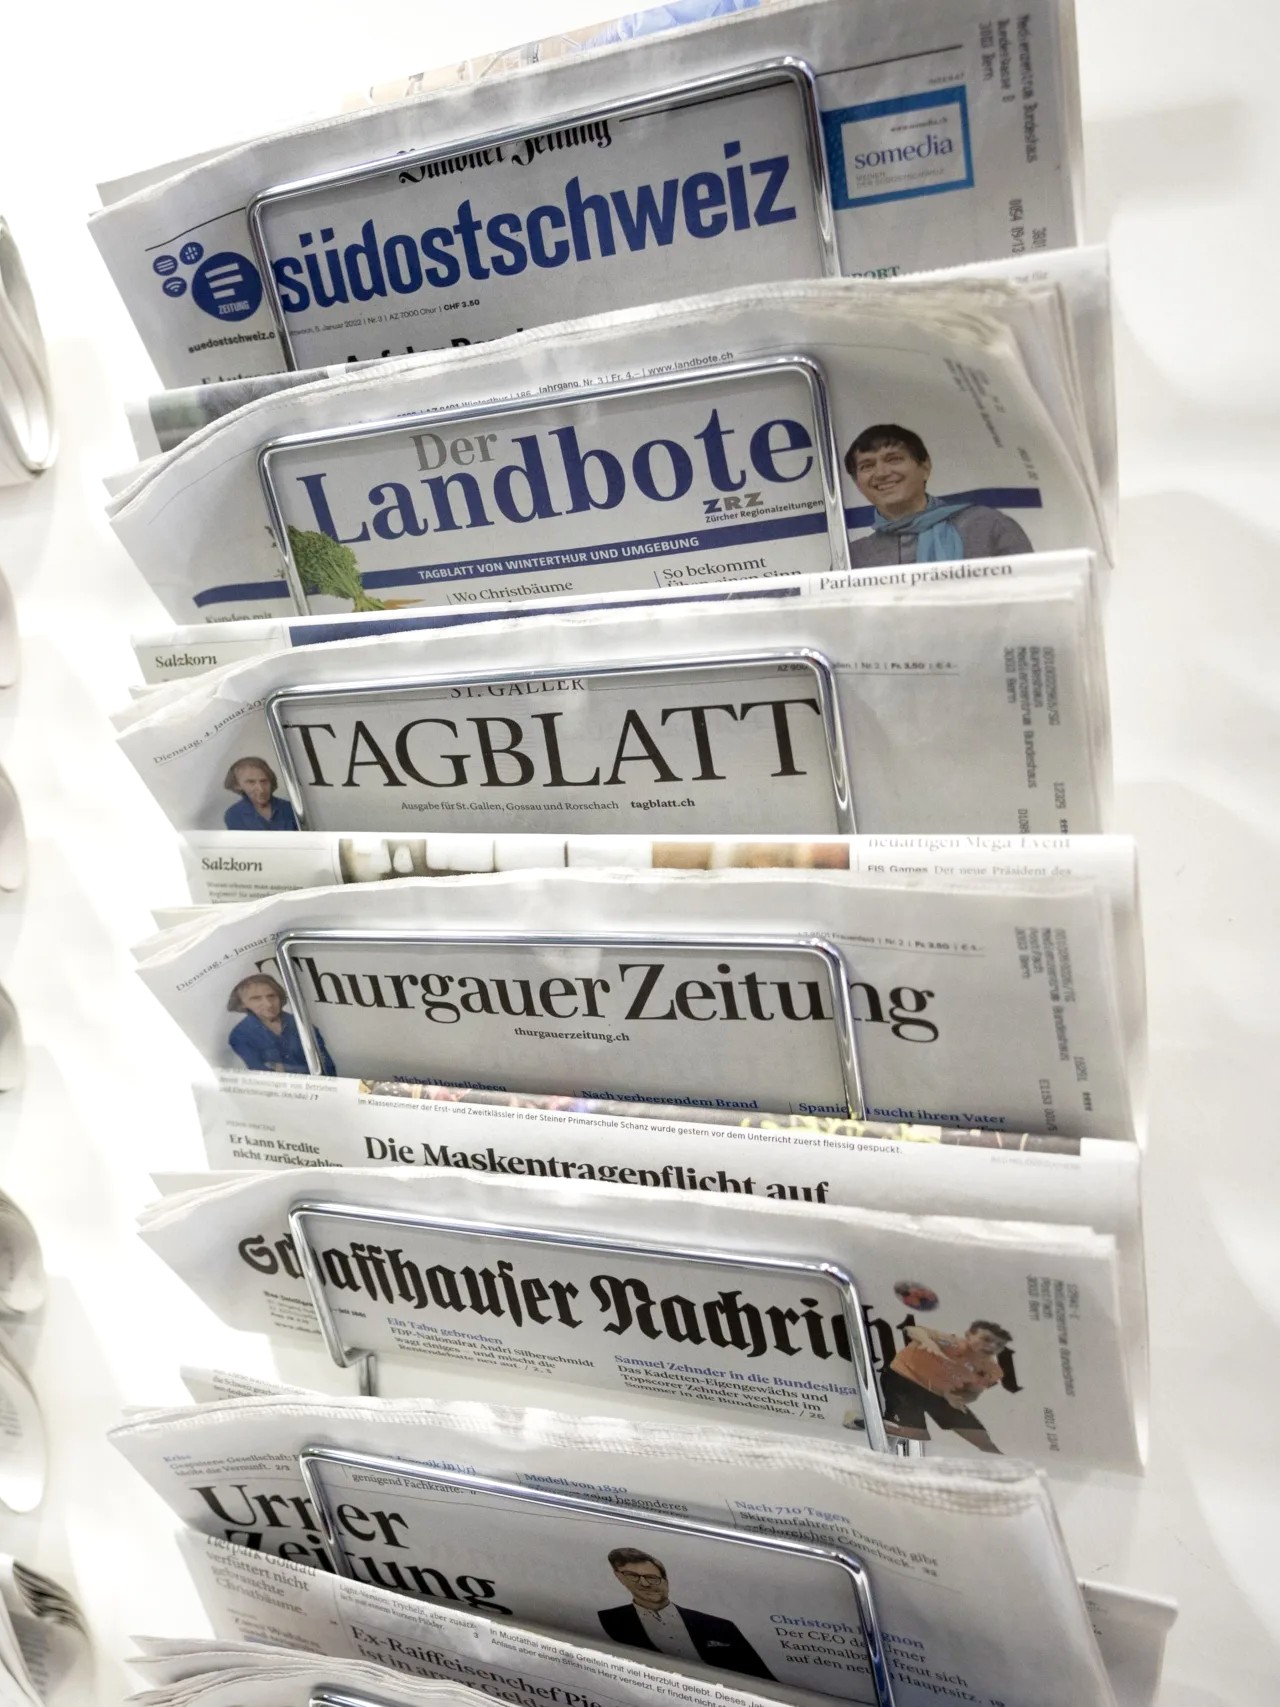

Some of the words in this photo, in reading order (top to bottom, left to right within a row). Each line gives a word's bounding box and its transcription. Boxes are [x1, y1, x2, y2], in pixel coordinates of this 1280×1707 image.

[854, 134, 953, 169] somedia
[274, 140, 798, 314] südostschweiz
[443, 302, 461, 312] CHF
[648, 351, 734, 376] www.landbote.ch
[409, 429, 498, 473] Der
[295, 408, 815, 546] Landbote
[703, 491, 764, 514] ZRZ
[705, 511, 738, 524] Zürcher
[740, 498, 824, 518] Regionalzeitungen
[418, 565, 475, 581] TAGBLATT
[476, 562, 504, 574] VON
[505, 552, 588, 570] WINTERTHUR
[590, 548, 619, 560] UND
[621, 535, 700, 557] UMGEBUNG
[662, 568, 684, 580] So
[686, 556, 768, 577] bekommt
[819, 569, 907, 591] Parlament
[910, 560, 1014, 586] präsidieren
[453, 590, 477, 603] Wo
[479, 580, 573, 600] Christbäume
[155, 653, 218, 669] Salzkorn
[153, 739, 203, 764] Dienstag,
[214, 707, 246, 732] Januar
[283, 695, 822, 788] TAGBLATT
[401, 801, 440, 812] Ausgabe
[440, 801, 455, 811] für
[470, 801, 505, 812] Gallen,
[506, 802, 542, 811] Gossau
[543, 801, 563, 811] und
[565, 801, 619, 811] Rorschach
[630, 798, 696, 810] tagblatt.ch
[201, 856, 263, 872] Salzkorn
[992, 864, 1046, 876] Präsident
[175, 959, 222, 992] Dienstag,
[233, 936, 268, 956] Januar
[618, 962, 939, 1044] Zeitung
[513, 1027, 631, 1043] thurgauerzeitung.ch
[581, 1089, 617, 1101] Nach
[716, 1098, 759, 1110] Brand
[367, 1098, 419, 1111] Klassenzimmer
[434, 1104, 451, 1113] Erst-
[452, 1106, 466, 1115] und
[467, 1107, 515, 1120] Zweitklässler
[525, 1112, 538, 1121] der
[539, 1113, 566, 1124] Steiner
[568, 1116, 619, 1129] Primarschule
[620, 1121, 649, 1132] Schanz
[650, 1124, 676, 1134] wurde
[678, 1128, 710, 1137] gestern
[726, 1130, 746, 1140] dem
[747, 1132, 791, 1145] Unterricht
[793, 1137, 821, 1147] zuerst
[823, 1139, 855, 1151] fleissig
[856, 1142, 903, 1155] gespuckt.
[873, 1107, 916, 1119] sucht
[918, 1108, 960, 1122] ihren
[962, 1112, 1006, 1124] Vater
[229, 1133, 242, 1144] Er
[244, 1135, 275, 1149] kann
[277, 1138, 320, 1155] Kredite
[233, 1148, 262, 1161] nicht
[363, 1135, 415, 1164] Die
[421, 1142, 757, 1195] Maskentragepflicht
[766, 1180, 829, 1204] auf
[387, 1316, 407, 1328] Ein
[407, 1320, 438, 1334] Tabu
[440, 1324, 504, 1346] gebrochen
[390, 1326, 477, 1349] FDP-Nationalrat
[480, 1342, 512, 1355] Andri
[513, 1348, 596, 1368] Silberschmidt
[394, 1336, 421, 1347] wagt
[422, 1340, 461, 1353] einiges
[473, 1350, 495, 1359] und
[497, 1352, 536, 1366] mischt
[537, 1359, 556, 1369] die
[614, 1353, 665, 1370] Samuel
[668, 1361, 727, 1379] Zehnder
[729, 1370, 745, 1381] in
[747, 1373, 769, 1385] die
[772, 1375, 858, 1396] Bundesliga
[618, 1364, 642, 1376] Das
[644, 1368, 798, 1399] Kadetten-Eigengewächs
[801, 1391, 829, 1403] und
[620, 1373, 684, 1391] Topscorer
[685, 1382, 739, 1399] Zehnder
[741, 1391, 800, 1409] wechselt
[802, 1402, 821, 1412] im
[623, 1380, 677, 1396] Sommer
[695, 1392, 716, 1403] die
[718, 1397, 796, 1416] Bundesliga.
[352, 1471, 402, 1488] genügend
[523, 1472, 569, 1487] Modell
[571, 1480, 595, 1491] von
[597, 1483, 628, 1495] 1830
[734, 1500, 773, 1514] Nach
[774, 1506, 802, 1516] 710
[803, 1506, 851, 1524] Tagen
[740, 1511, 850, 1536] Skirennfahrerin
[851, 1529, 907, 1558] Danioth
[910, 1551, 939, 1567] gibt
[837, 1535, 915, 1570] Comeback.
[206, 1551, 271, 1579] verfüttert
[273, 1571, 310, 1592] nicht
[449, 1616, 478, 1630] zusätz-
[770, 1613, 853, 1635] Christoph
[775, 1626, 804, 1640] Der
[807, 1631, 845, 1646] CEO
[351, 1625, 564, 1702] Ex-Raiffeisenchef
[358, 1645, 389, 1663] ist
[391, 1653, 412, 1672] in
[491, 1637, 518, 1651] Anlass
[538, 1652, 561, 1664] einen
[561, 1657, 583, 1670] Stich
[597, 1667, 617, 1680] Herz
[619, 1676, 655, 1693] versetzt.
[667, 1686, 693, 1703] findet
[499, 1631, 538, 1648] Muotathal
[540, 1641, 558, 1653] wird
[558, 1647, 574, 1659] das
[576, 1652, 609, 1669] Greifeln
[610, 1661, 625, 1673] mit
[627, 1665, 641, 1677] viel
[643, 1671, 680, 1689] Herzblut
[681, 1681, 712, 1698] gelebt.
[714, 1690, 746, 1706] Dieses
[893, 1659, 932, 1677] freut
[935, 1670, 969, 1688] sich
[786, 1653, 810, 1665] auf
[813, 1655, 842, 1670] den
[898, 1672, 982, 1705] Hauptsitz.
